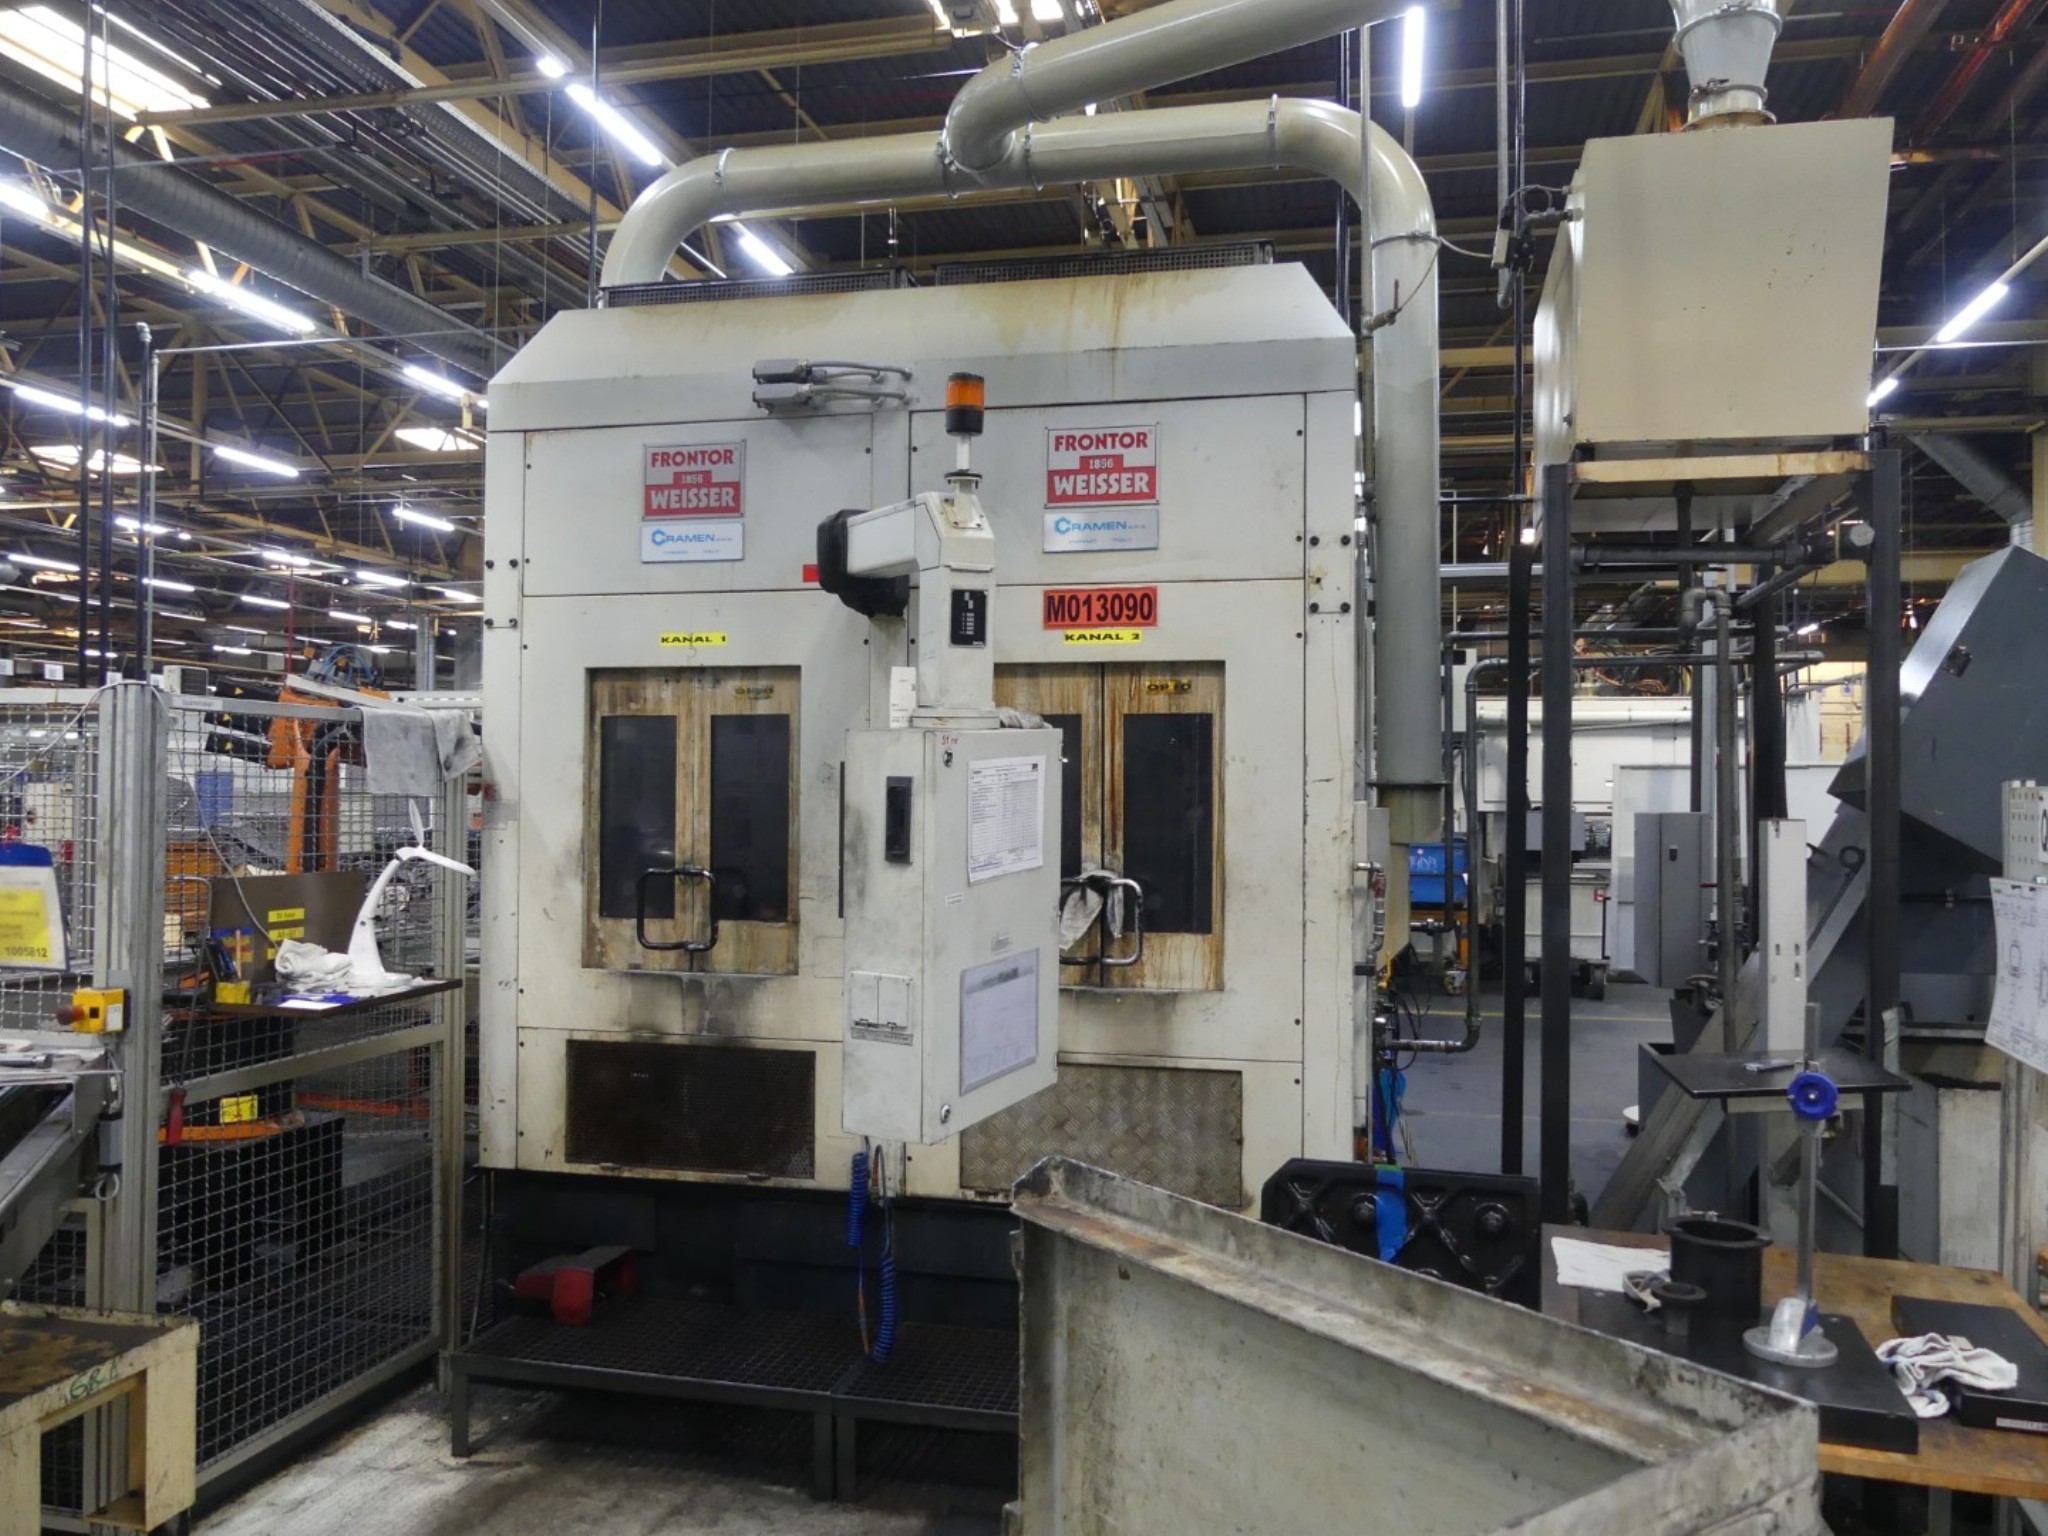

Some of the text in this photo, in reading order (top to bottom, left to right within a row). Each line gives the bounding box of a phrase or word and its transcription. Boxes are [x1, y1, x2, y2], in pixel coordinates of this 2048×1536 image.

[1054, 431, 1148, 452] FRONTOR
[651, 449, 734, 468] FRONTOR
[1088, 458, 1115, 470] 1856
[1053, 471, 1150, 496] WEISSER
[650, 487, 736, 510] WEISSER
[1054, 516, 1127, 536] CRAMEN
[651, 529, 716, 547] CRAMEN
[1047, 592, 1153, 623] M013090
[660, 635, 714, 644] KANAL
[1064, 632, 1141, 642] KANAL 2
